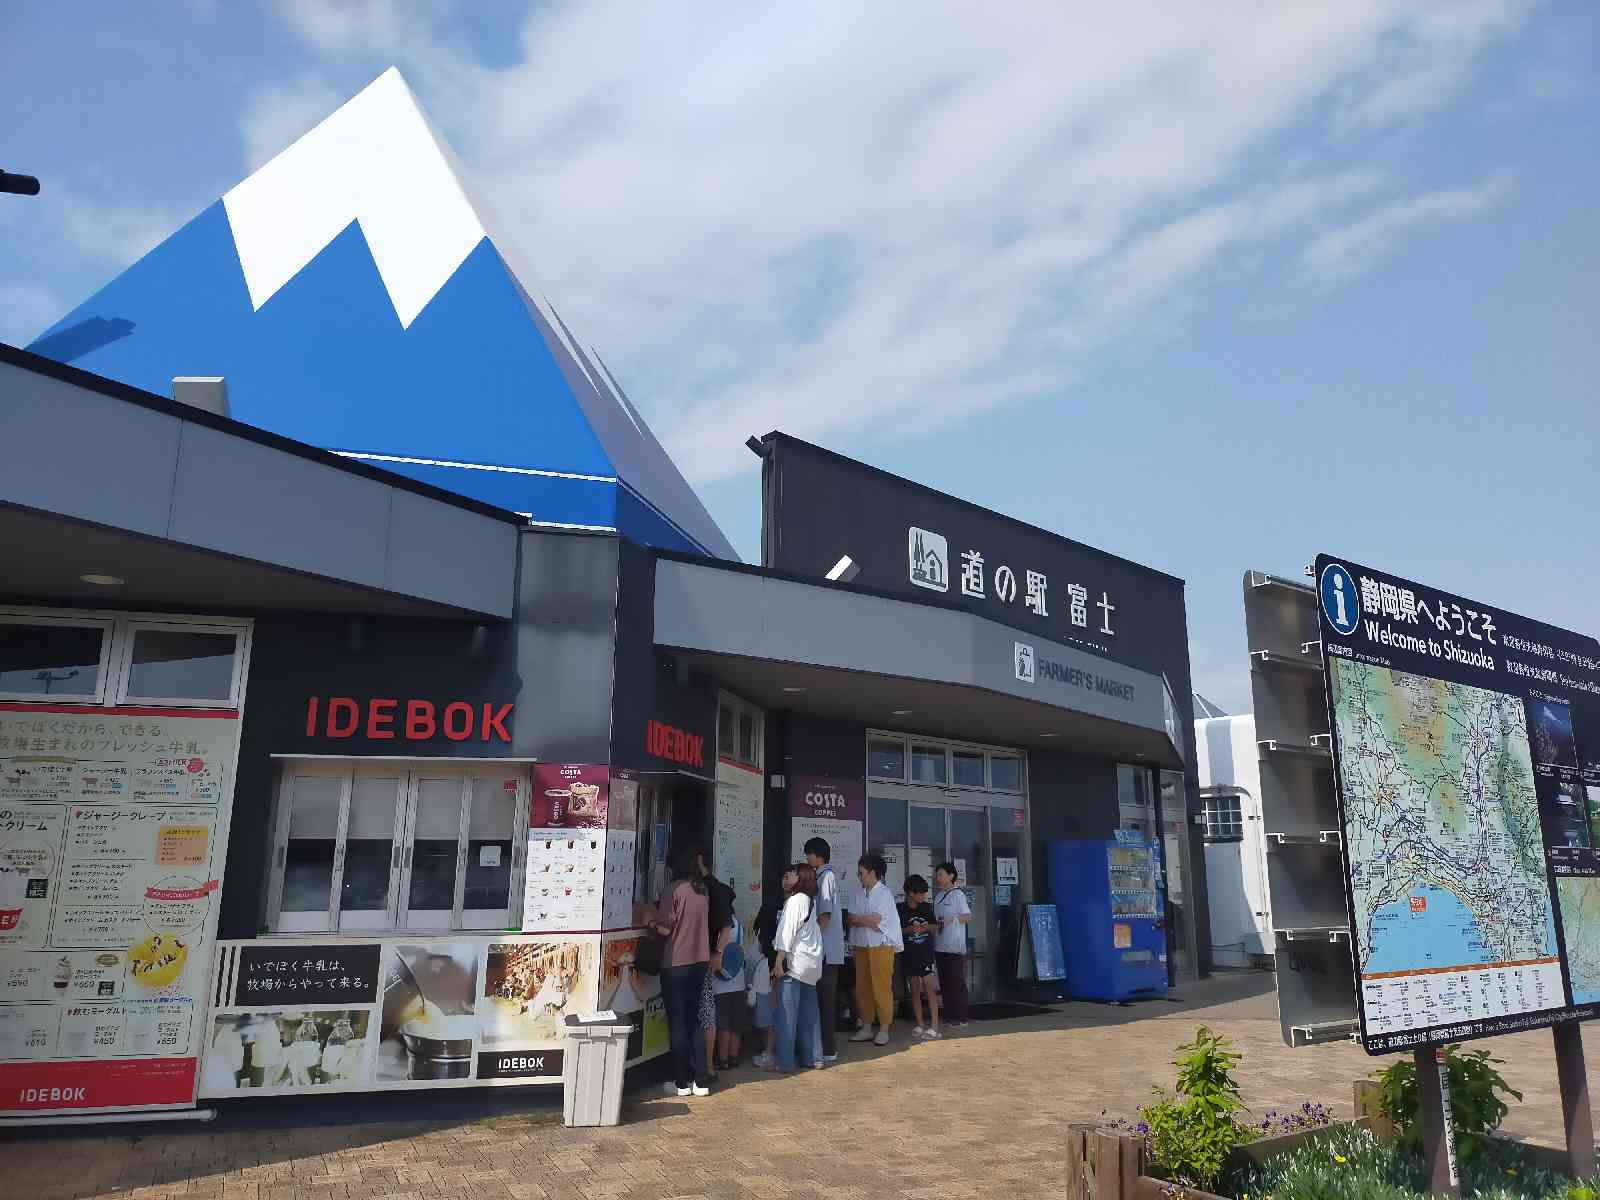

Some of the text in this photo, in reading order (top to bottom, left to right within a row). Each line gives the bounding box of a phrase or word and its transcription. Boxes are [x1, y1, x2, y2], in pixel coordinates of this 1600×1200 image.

[960, 549, 1115, 635] 道の駅 富士
[1360, 575, 1496, 646] 静岡県へようこそ
[1363, 619, 1427, 655] Welcome
[1429, 637, 1442, 658] to
[1443, 639, 1495, 671] Shizuoka
[1039, 658, 1136, 701] FARMER'S MARKET
[306, 696, 514, 743] IDEBOK
[647, 719, 704, 768] IDEBOK
[806, 792, 847, 809] COSTA
[247, 976, 370, 991] 牧場からやって来る。
[498, 1057, 545, 1069] IDEBOK
[19, 1087, 87, 1103] IDEBOK
